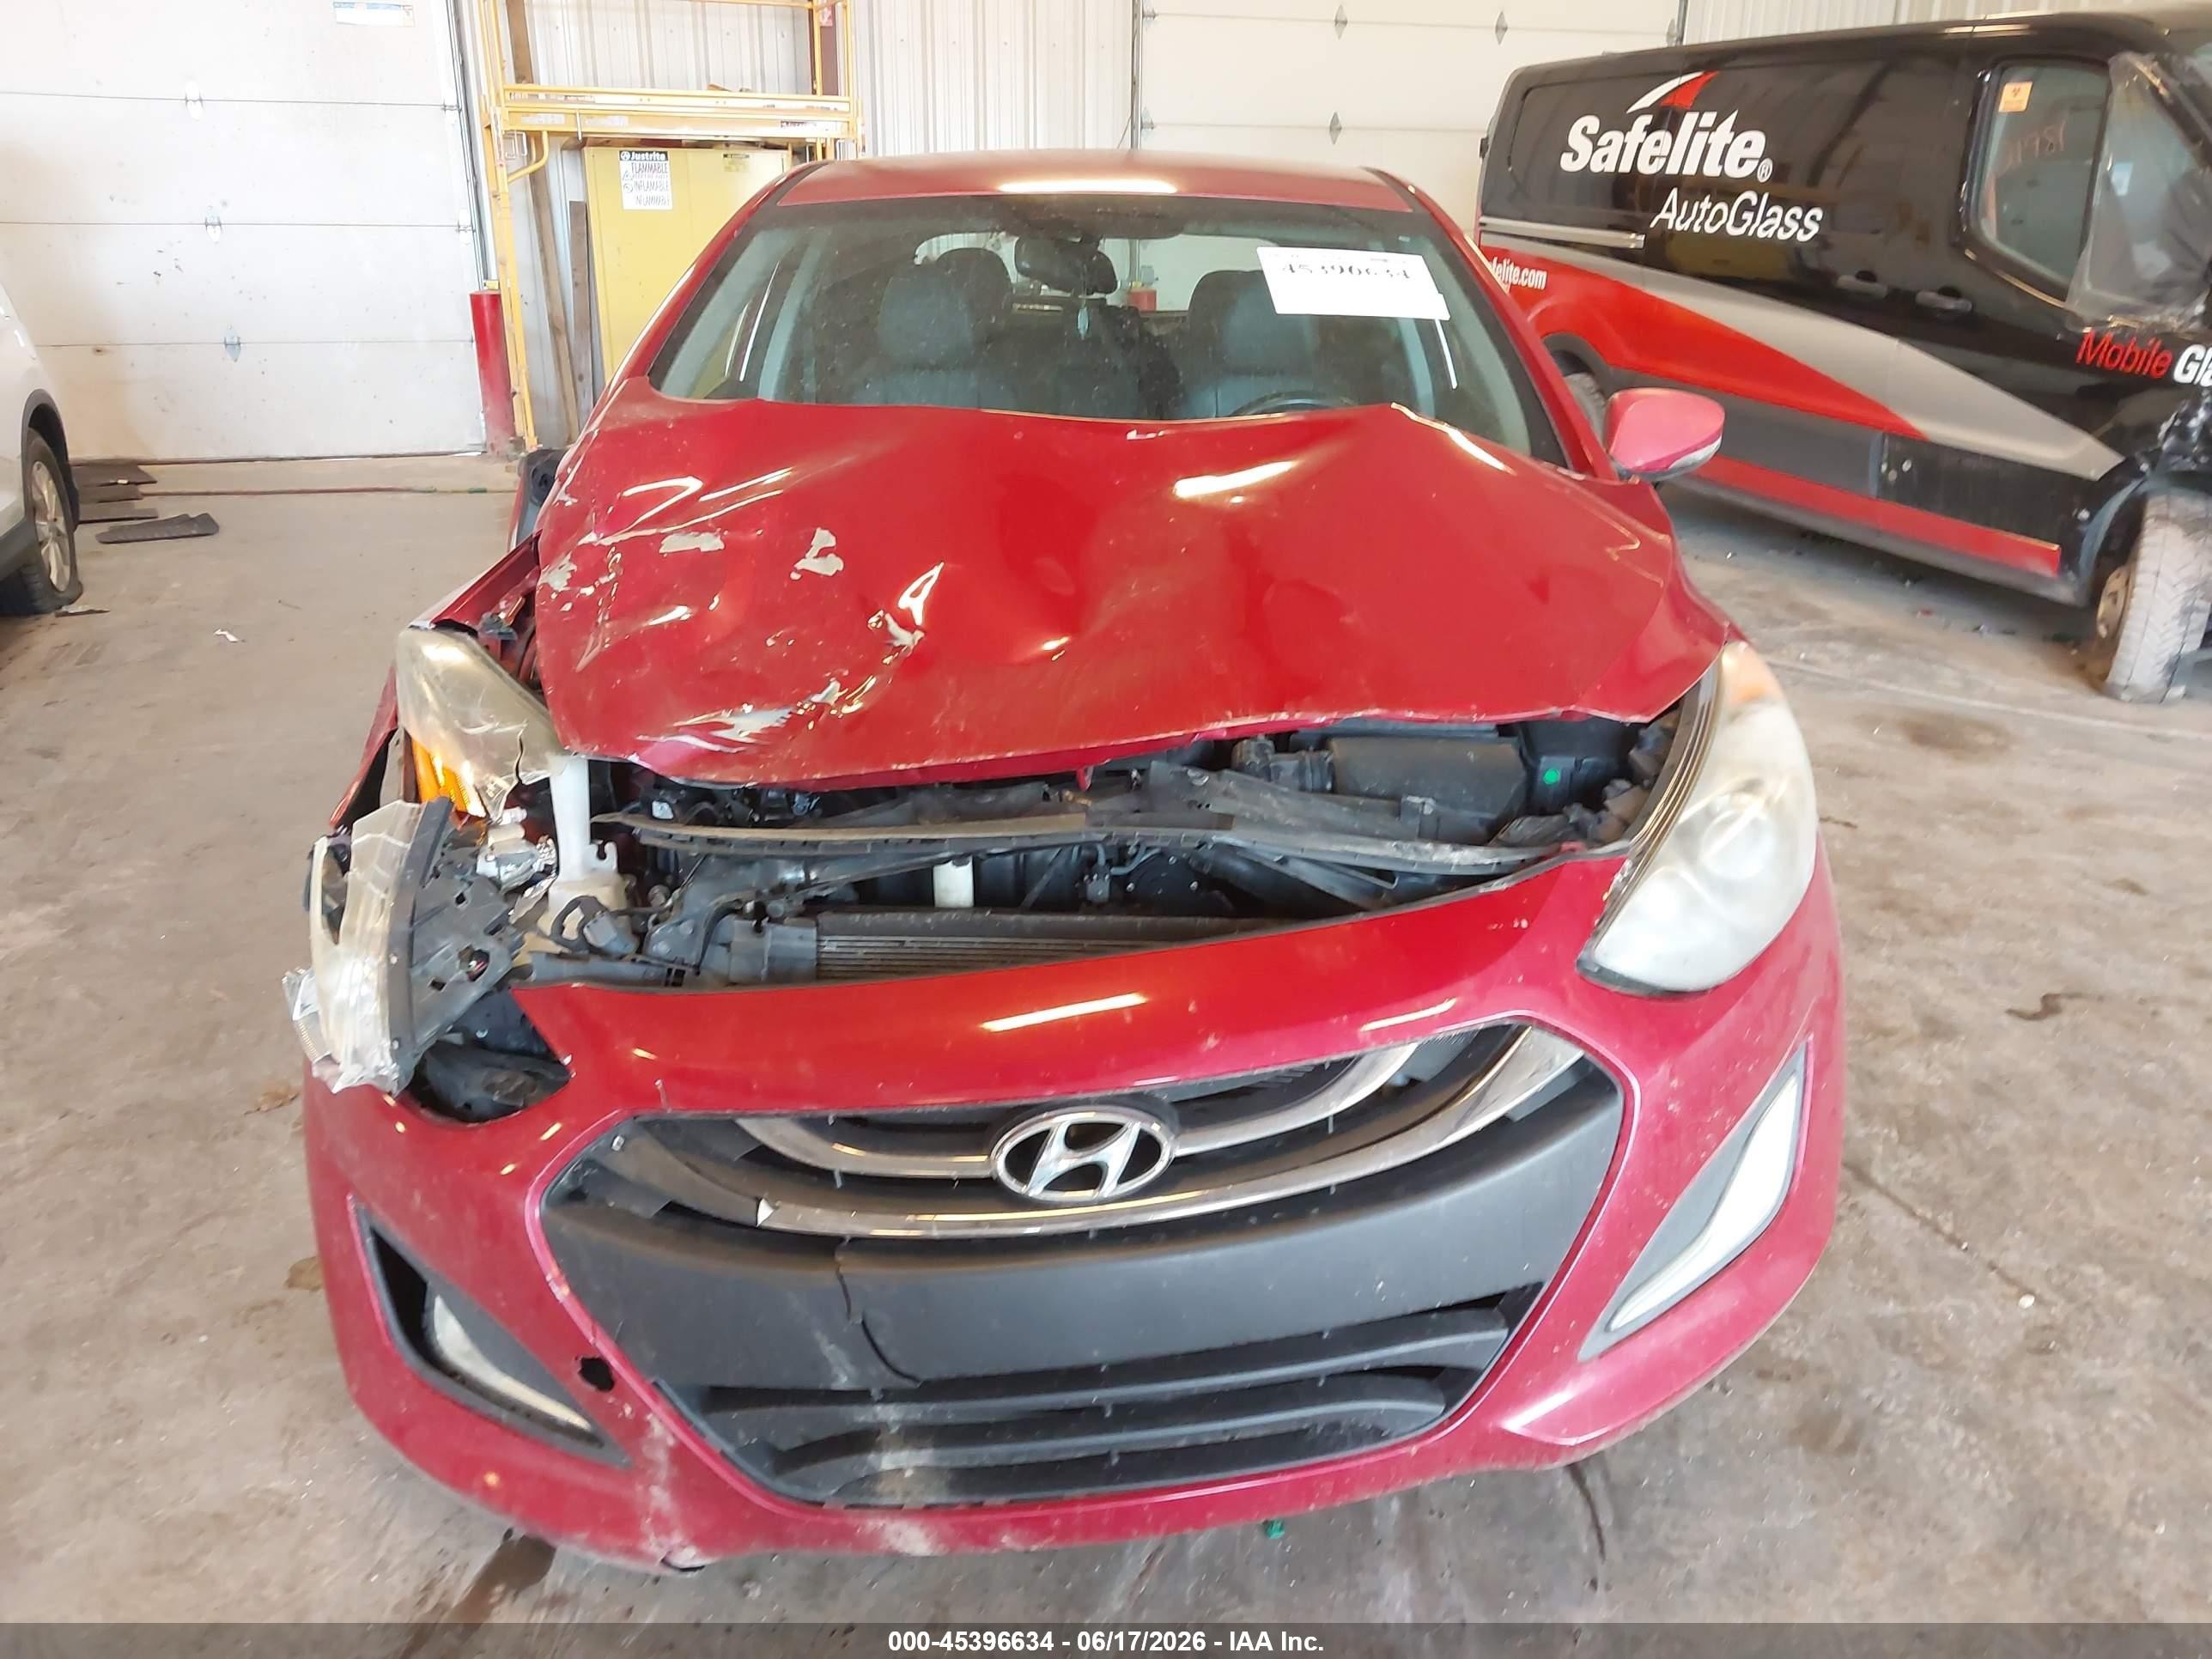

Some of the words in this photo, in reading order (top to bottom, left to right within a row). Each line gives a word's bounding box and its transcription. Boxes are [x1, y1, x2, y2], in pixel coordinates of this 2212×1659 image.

[631, 162, 668, 173] FLAMMABLE
[1650, 187, 1823, 242] AutoGlass
[2075, 329, 2173, 379] Mobile
